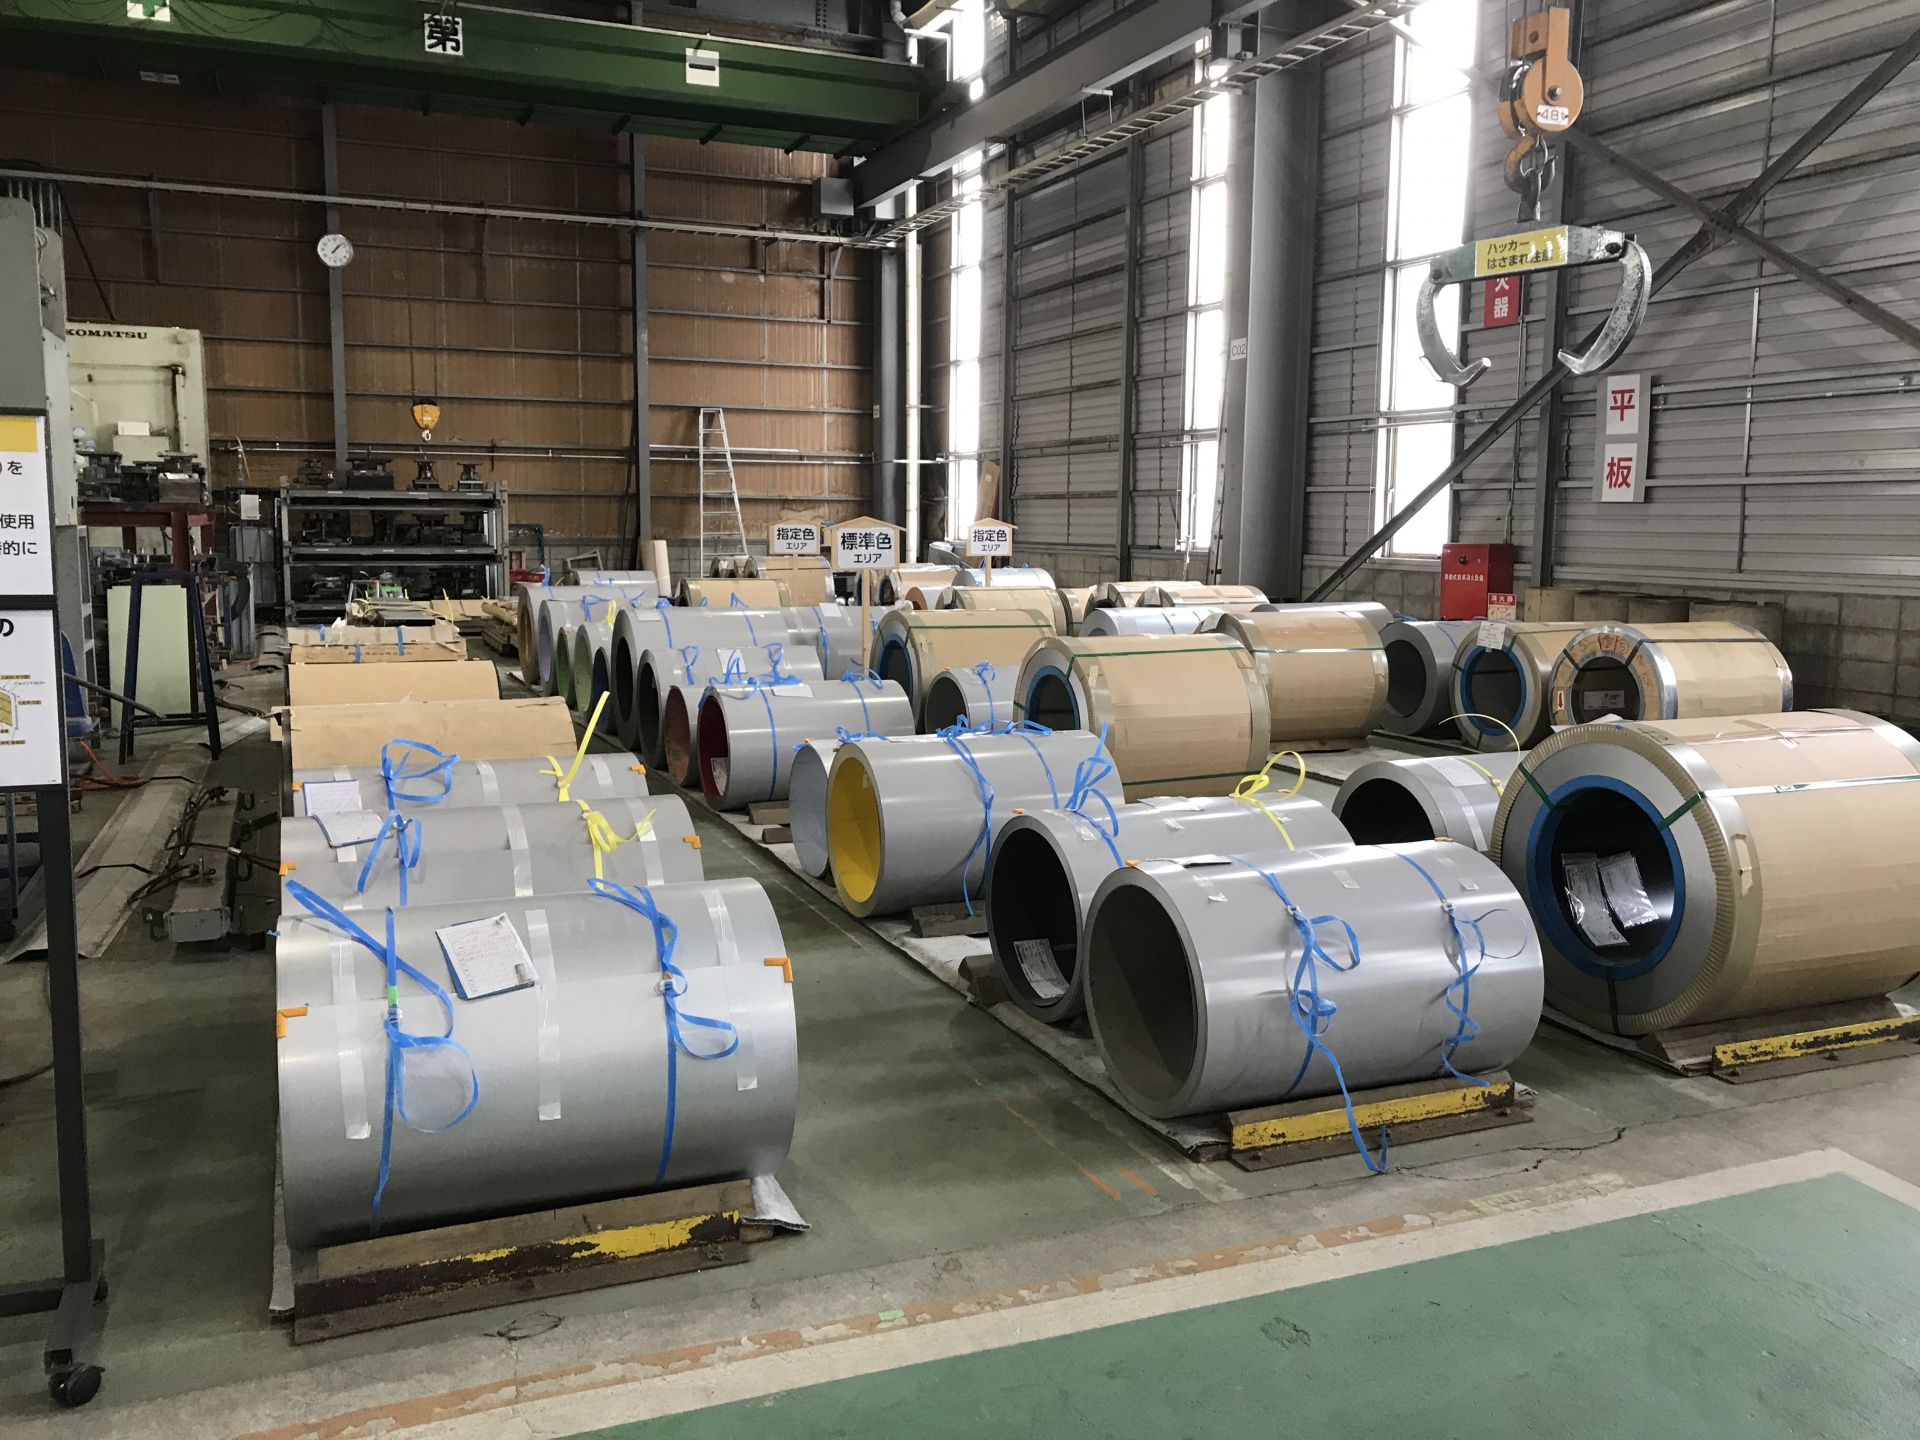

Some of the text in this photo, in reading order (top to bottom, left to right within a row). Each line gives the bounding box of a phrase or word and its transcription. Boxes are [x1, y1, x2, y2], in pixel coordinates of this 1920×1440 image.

[424, 14, 461, 52] 第
[1487, 240, 1530, 255] ハッカー
[65, 329, 148, 340] KOMATSU
[1606, 388, 1636, 489] 平板
[776, 527, 815, 541] 指定色
[840, 532, 892, 550] 標準色
[973, 529, 1008, 542] 指定色
[0, 541, 38, 556] 的に
[785, 542, 808, 550] エリア
[980, 544, 1001, 552] エリア
[853, 553, 882, 564] エリア
